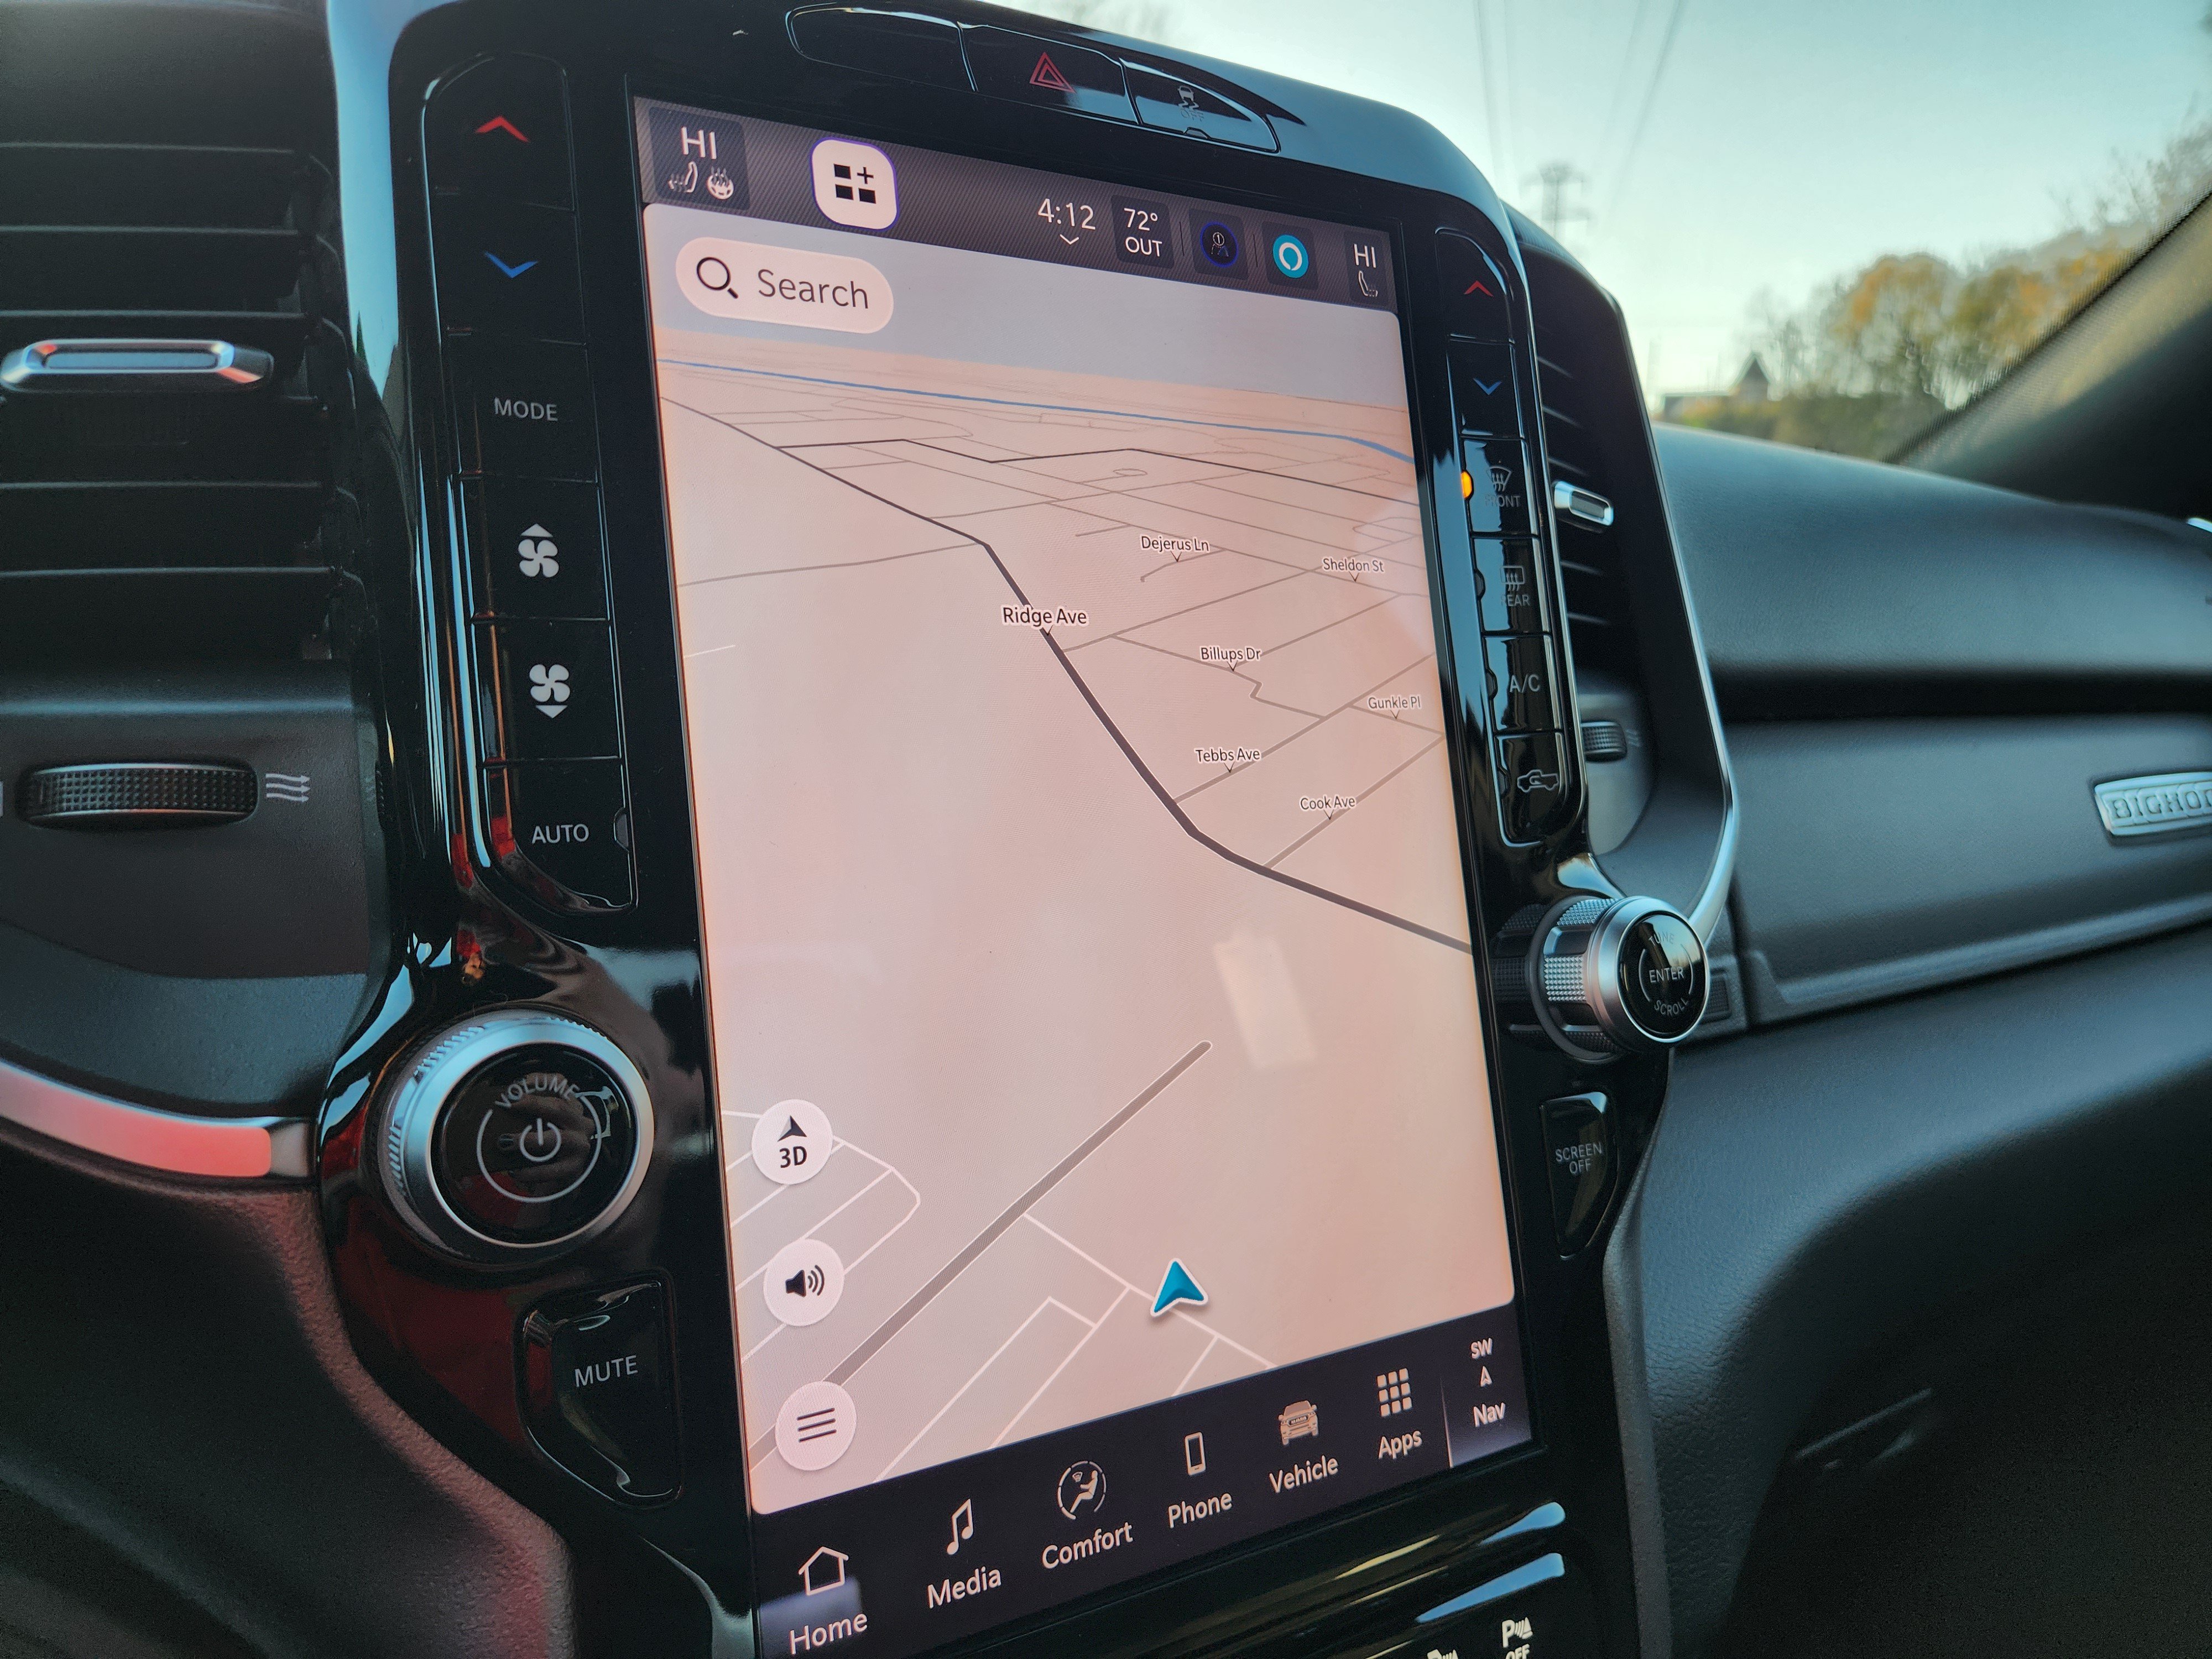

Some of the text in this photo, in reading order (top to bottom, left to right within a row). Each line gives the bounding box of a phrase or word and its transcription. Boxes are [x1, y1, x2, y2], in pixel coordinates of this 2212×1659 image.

[681, 127, 717, 160] HI
[1037, 198, 1096, 231] 4:12
[1123, 207, 1159, 232] 72°
[1125, 236, 1162, 258] OUT
[1354, 244, 1376, 269] HI
[757, 269, 869, 310] Search
[494, 397, 559, 421] MODE
[1484, 493, 1521, 509] FRONT
[1141, 535, 1209, 552] Dejerus Ln
[1323, 558, 1384, 572] Sheldon St
[1500, 593, 1531, 607] REAR
[1003, 607, 1087, 627] Ridge Ave
[1201, 647, 1261, 663] Billups Dr
[1509, 673, 1541, 695] A/C
[1368, 696, 1421, 710] Gunkle Pl
[1196, 748, 1260, 762] Tebbs Ave
[1300, 796, 1356, 810] Cook Ave
[531, 823, 589, 844] AUTO
[1648, 931, 1674, 947] TUNE
[1649, 966, 1684, 983] ENTER
[1653, 996, 1689, 1016] SCROLL
[494, 1074, 580, 1108] VOLUME
[779, 1145, 808, 1169] 3D
[1555, 1142, 1602, 1162] SCREEN
[1568, 1159, 1592, 1175] OFF
[1470, 1337, 1493, 1359] SW
[574, 1355, 638, 1388] MUTE
[1473, 1400, 1506, 1427] Nav
[1378, 1428, 1423, 1460] Apps
[1269, 1455, 1339, 1493] Vehicle
[1168, 1491, 1233, 1528] Phone
[1042, 1521, 1134, 1569] Comfort
[927, 1566, 1002, 1609] Media
[789, 1609, 868, 1655] Home
